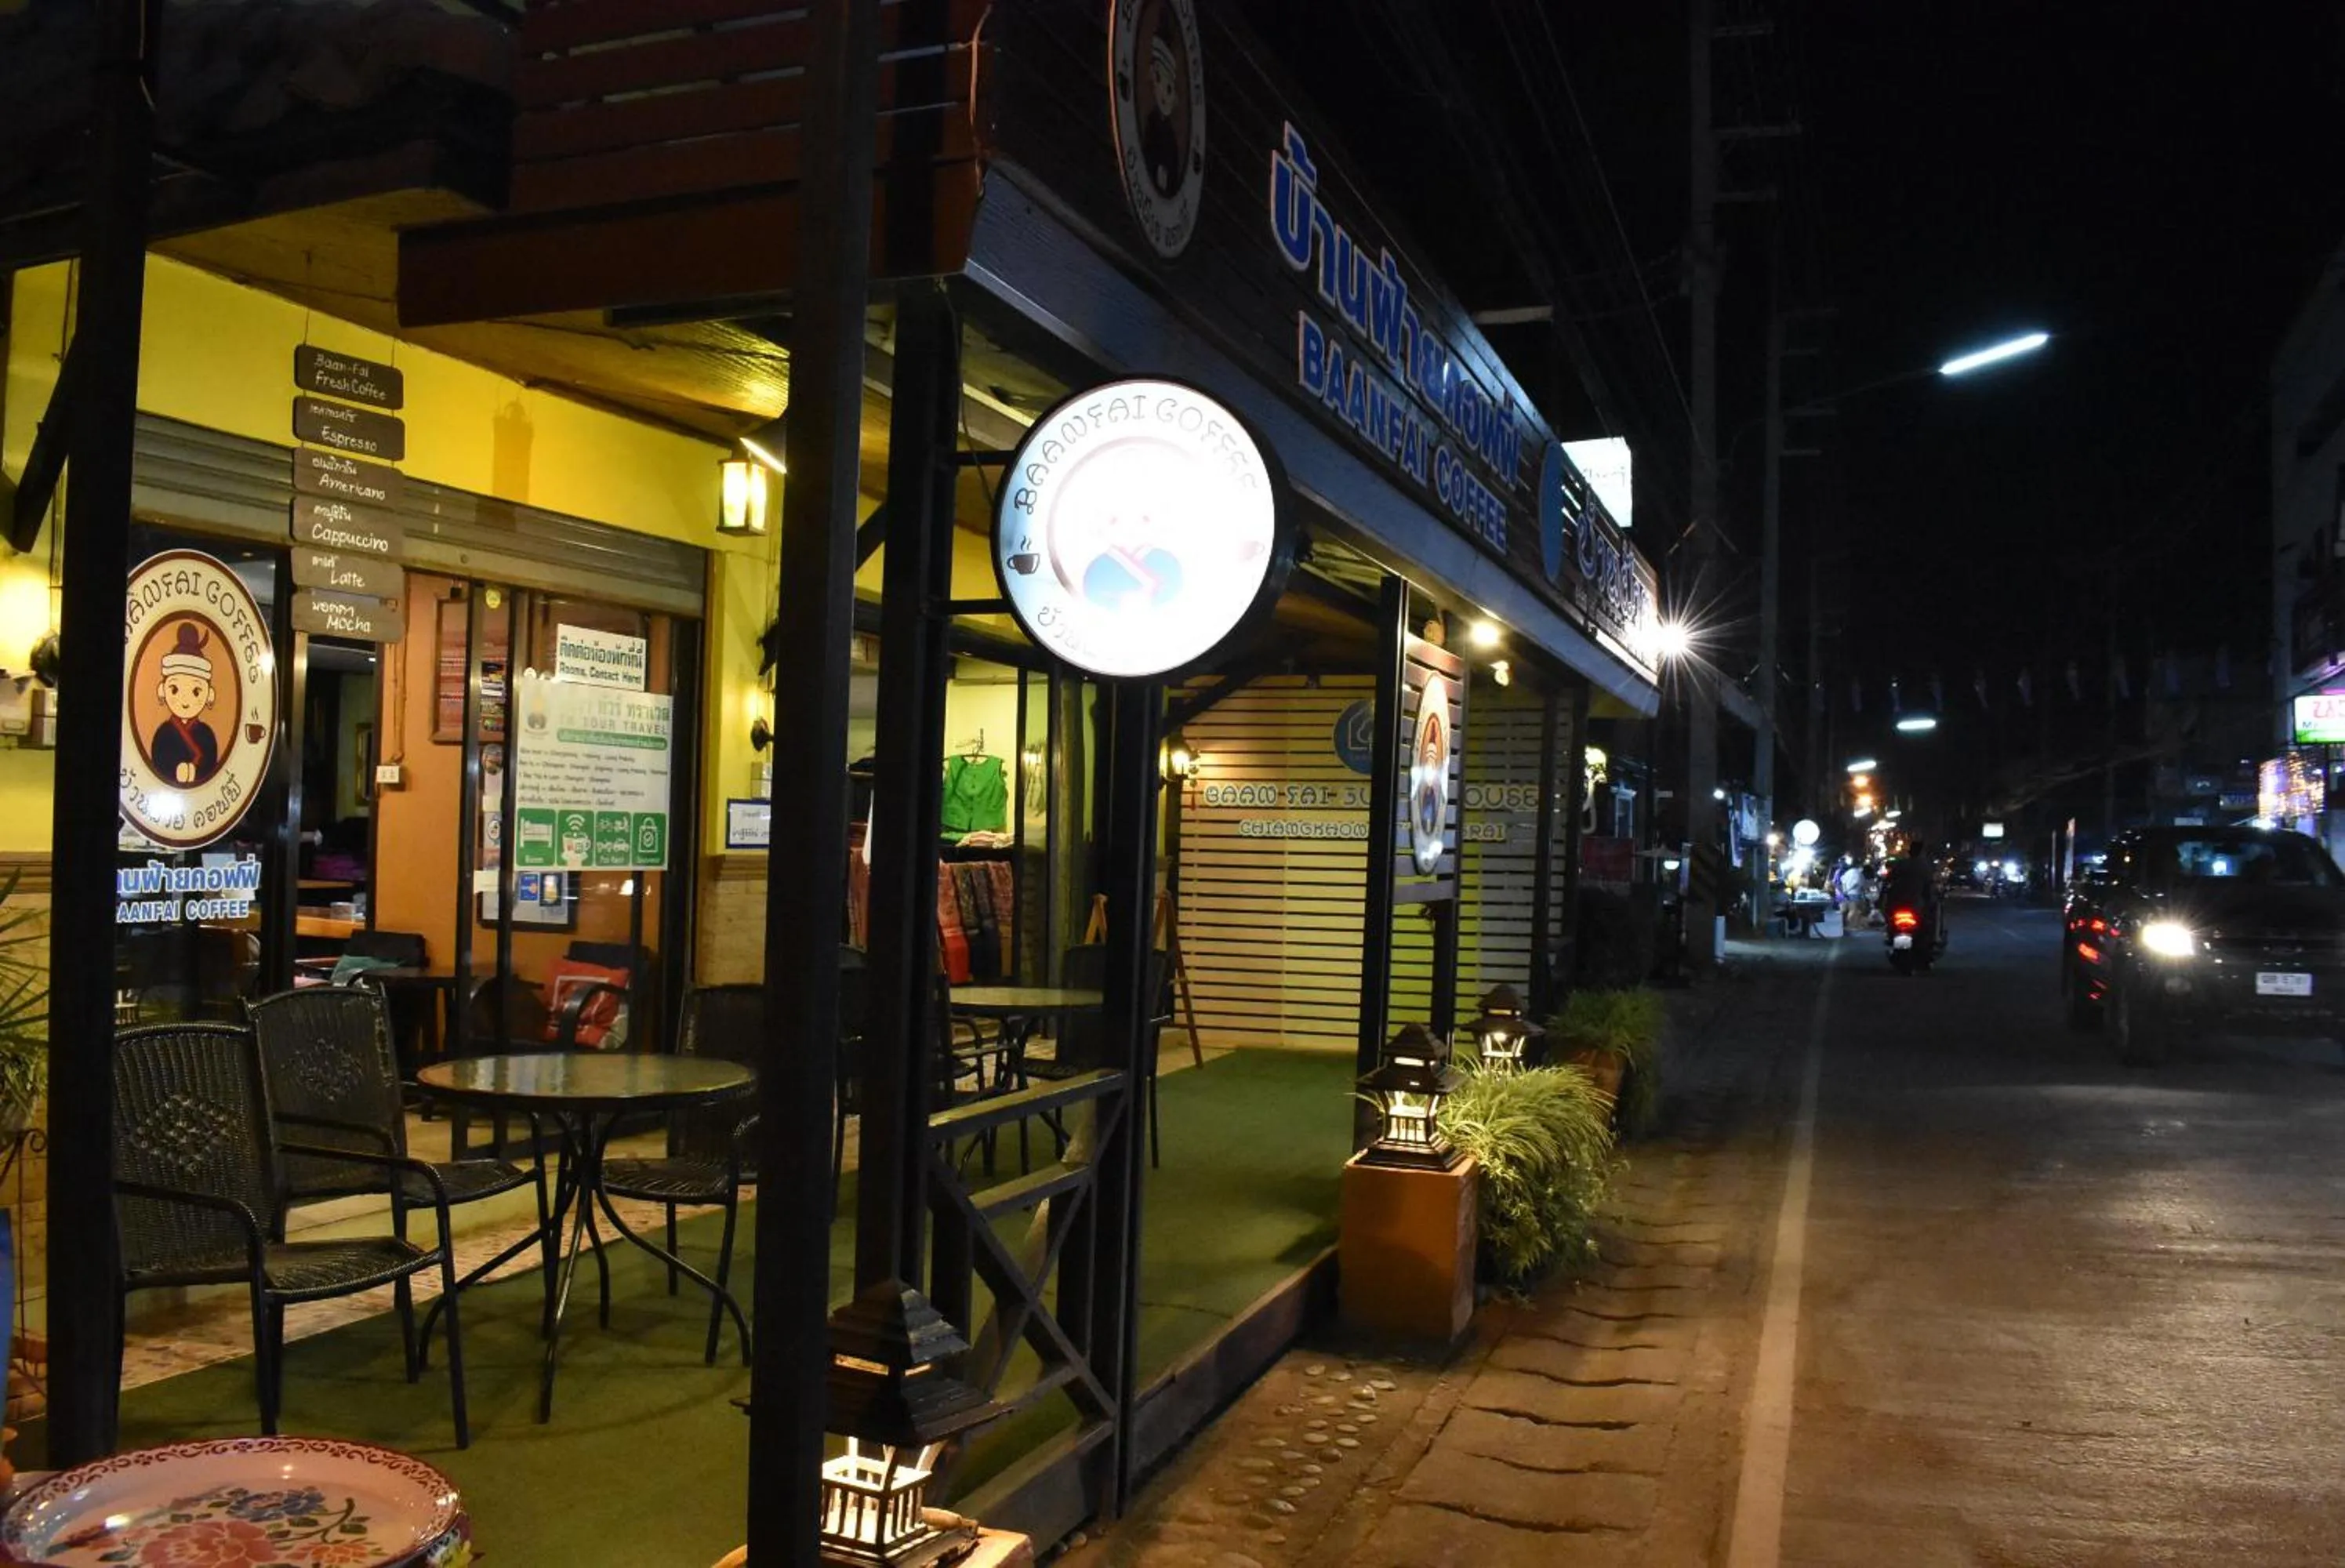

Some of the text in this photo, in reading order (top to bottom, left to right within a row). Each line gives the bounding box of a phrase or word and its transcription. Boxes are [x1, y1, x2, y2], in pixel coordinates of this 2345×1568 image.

[314, 373, 387, 401] Fresh Coffee
[321, 426, 378, 452] Espresso
[1298, 310, 1507, 555] BAANFAI COFFEE
[1014, 395, 1148, 515] BAANFAI
[318, 474, 386, 502] Americano
[311, 523, 389, 552] Cappuccino
[330, 572, 366, 588] Latte
[325, 614, 372, 634] Mocha
[589, 666, 620, 681] Contact
[623, 720, 669, 735] TRAVEL
[1205, 786, 1276, 805] BAAN
[1287, 786, 1329, 805] FAI
[1465, 786, 1539, 807] OUSE
[1240, 823, 1369, 837] CHIANGKHON
[118, 853, 262, 895] นฝ้ายคอฟฟี่
[117, 900, 249, 923] AANFAI COFFEE
